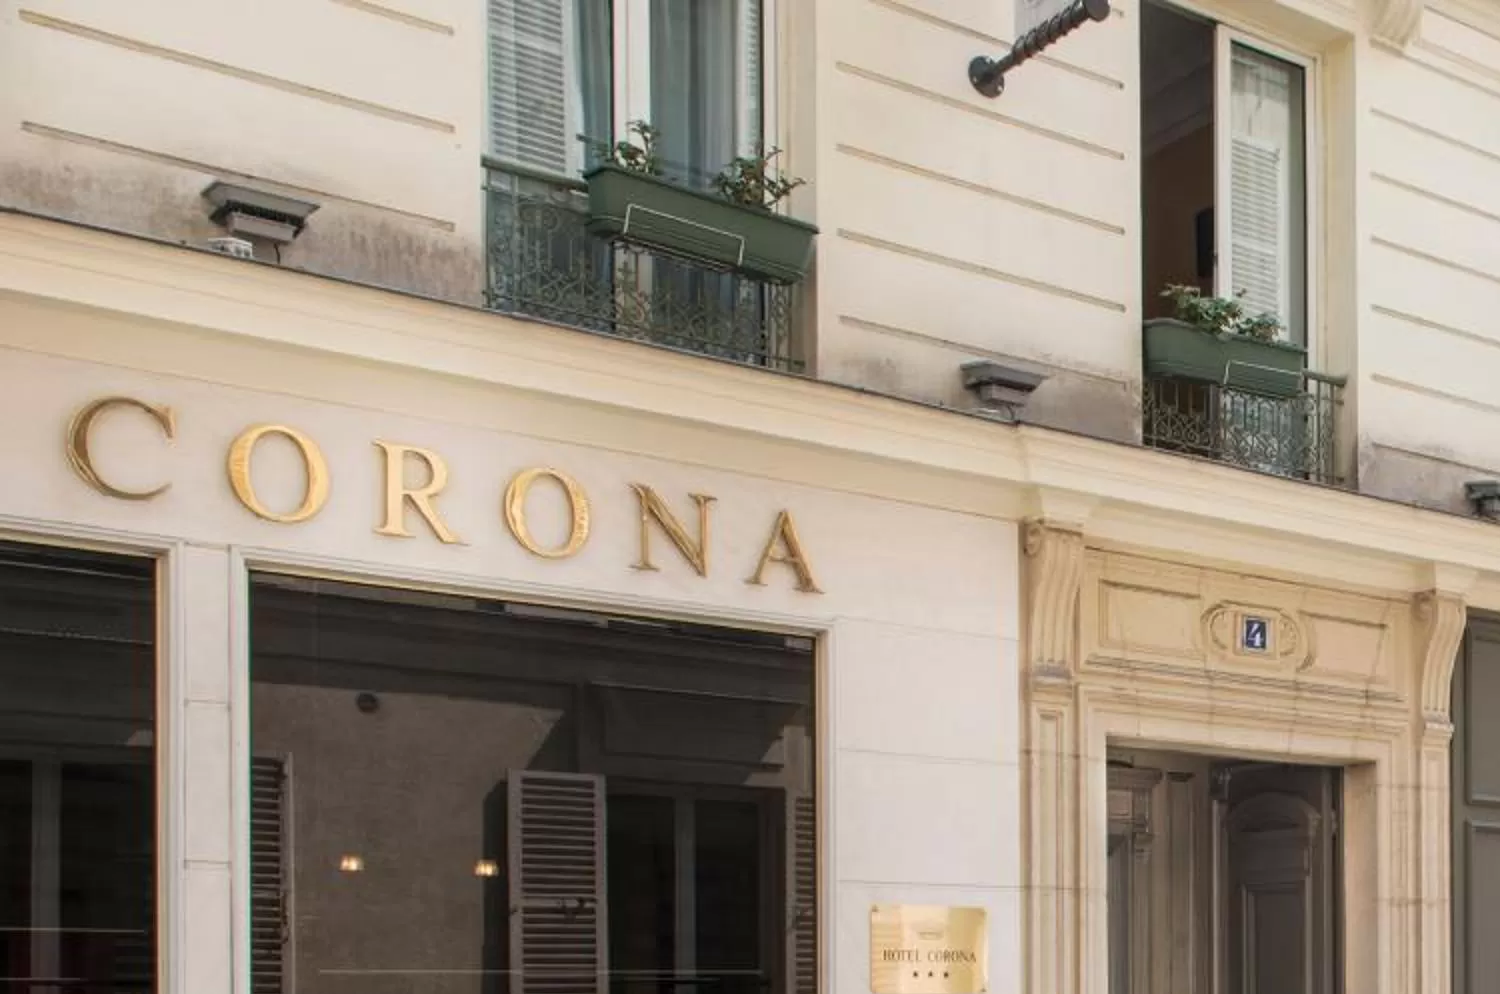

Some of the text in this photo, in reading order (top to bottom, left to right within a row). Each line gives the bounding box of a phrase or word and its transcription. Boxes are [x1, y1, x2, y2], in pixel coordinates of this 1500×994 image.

[66, 396, 824, 595] CORONA
[883, 949, 977, 963] HOTEL CORONA
